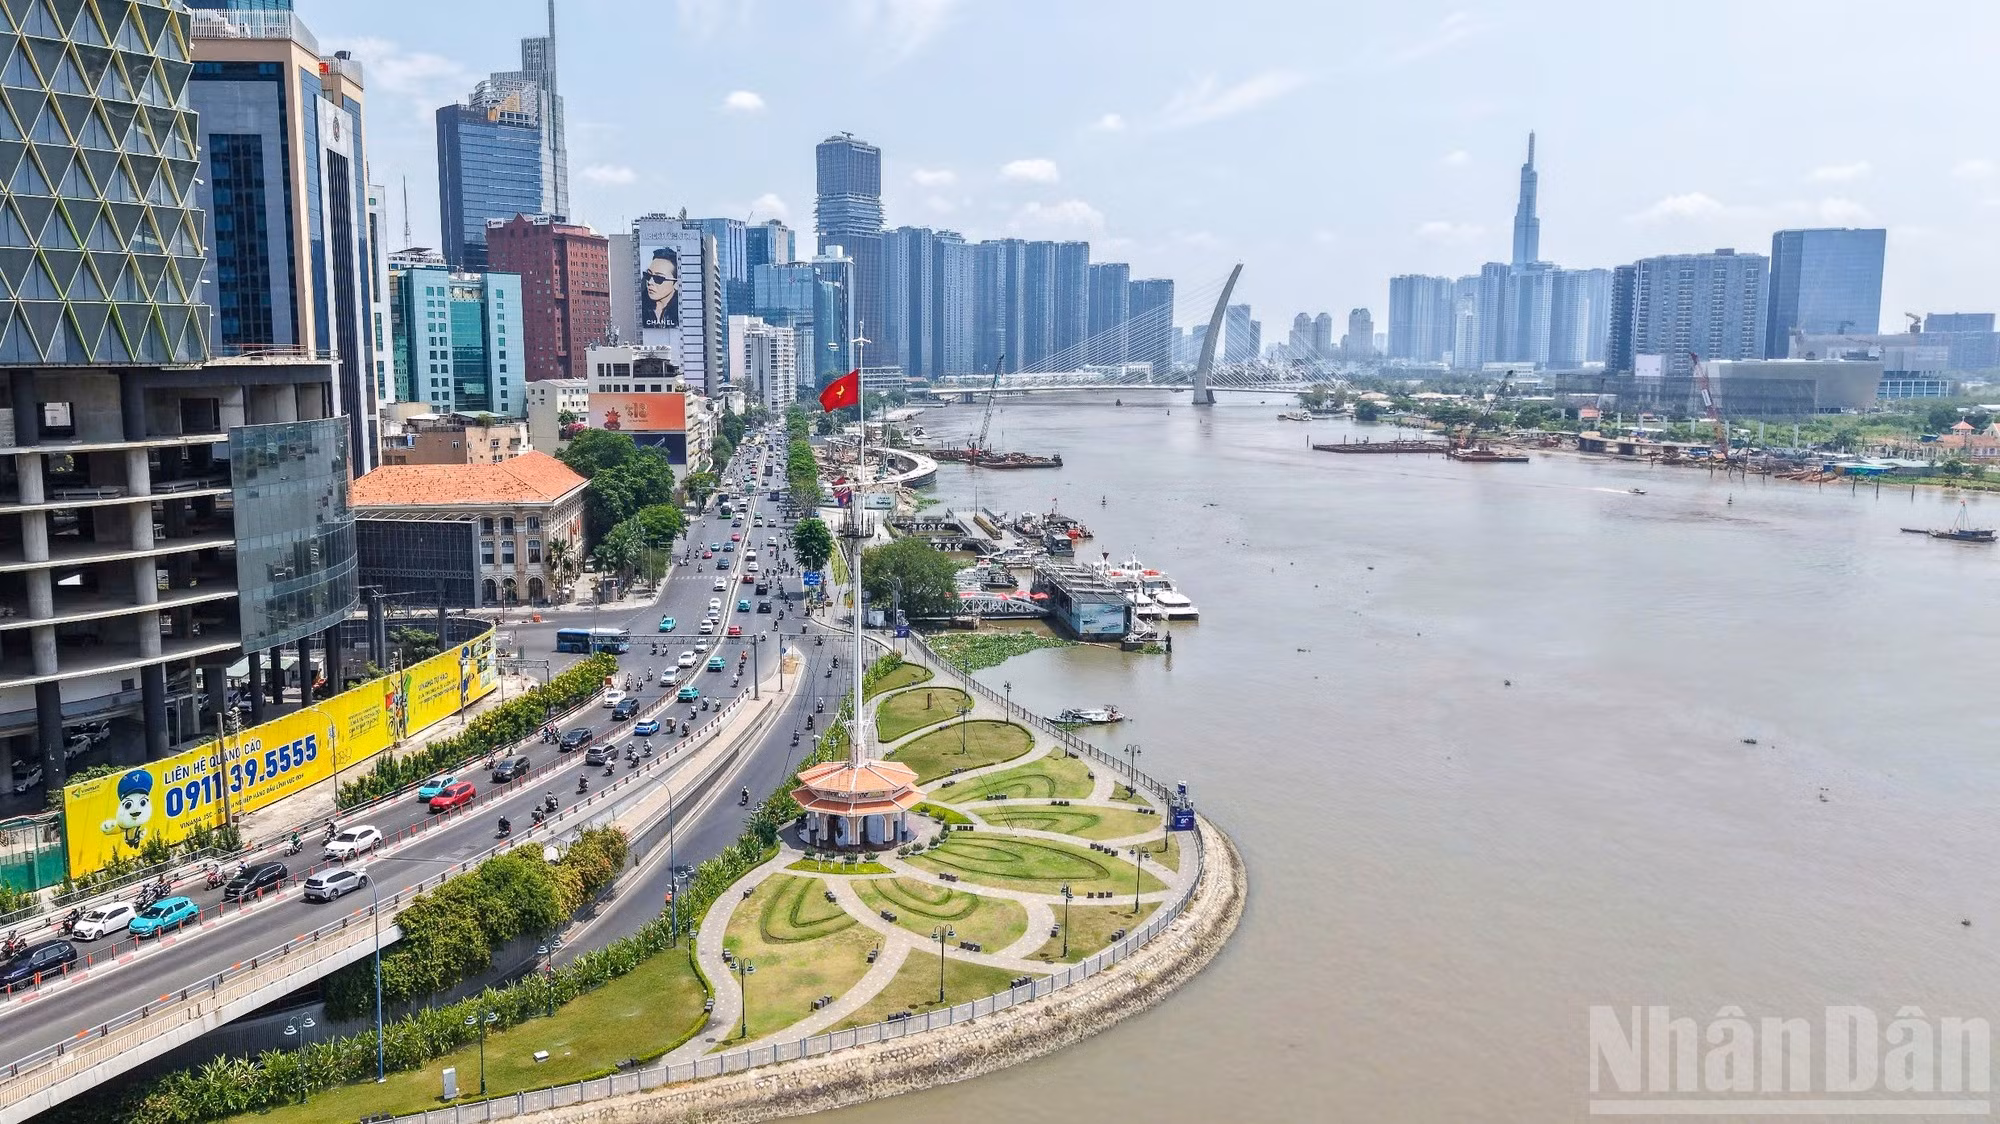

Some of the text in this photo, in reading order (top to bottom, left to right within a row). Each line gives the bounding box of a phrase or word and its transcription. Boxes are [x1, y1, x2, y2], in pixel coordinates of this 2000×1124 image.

[164, 763, 190, 785] LIÊN
[193, 757, 207, 775] HỆ
[244, 738, 261, 755] CÁO
[165, 734, 318, 818] 091139.5555
[180, 816, 202, 829] VINAMA
[203, 811, 213, 820] JSC
